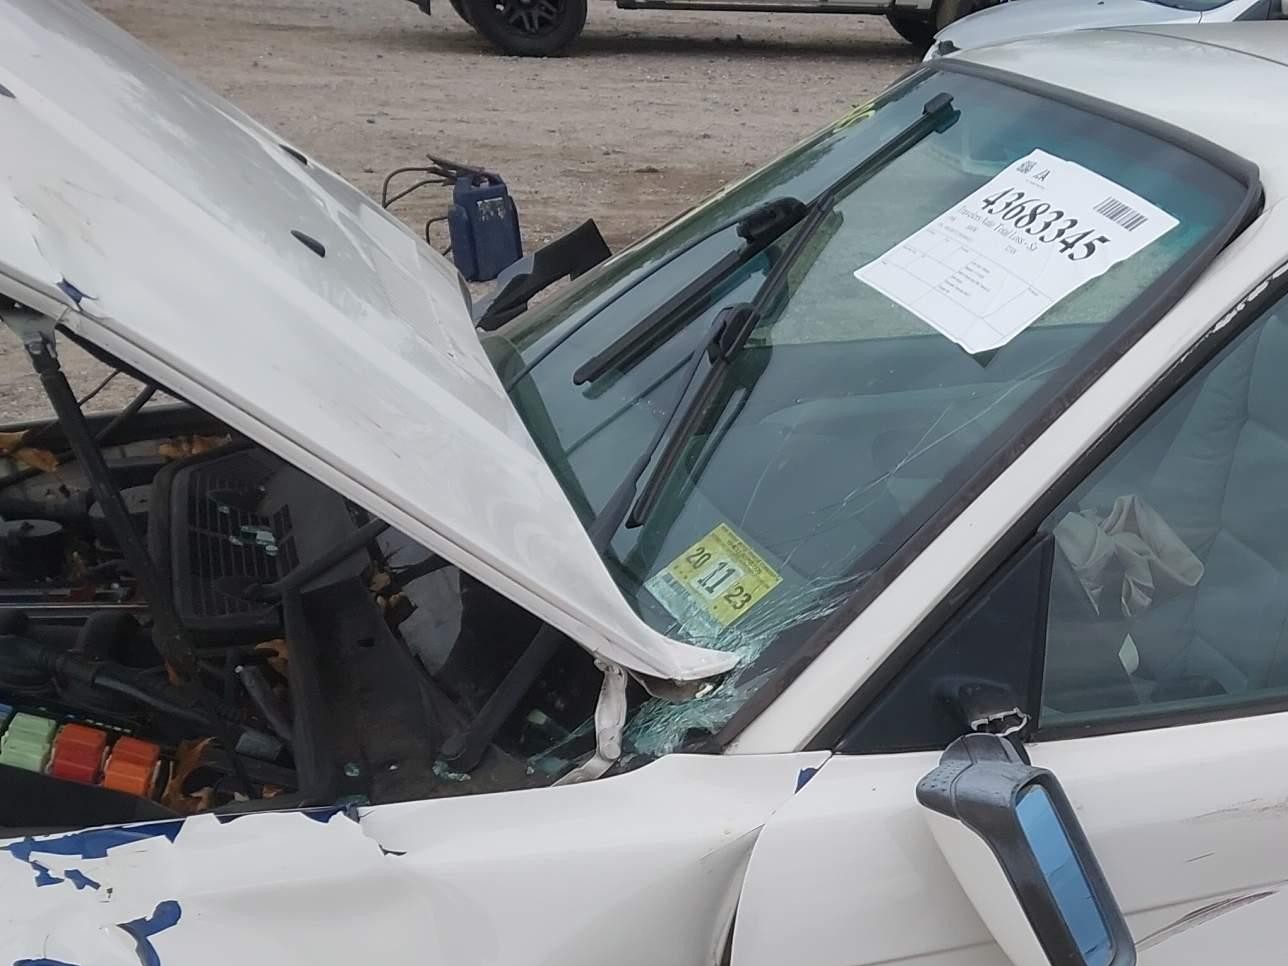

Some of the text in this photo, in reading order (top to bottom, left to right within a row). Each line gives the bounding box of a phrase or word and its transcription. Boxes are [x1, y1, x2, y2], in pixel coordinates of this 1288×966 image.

[982, 187, 1110, 262] 43683345
[686, 547, 712, 570] 20
[697, 561, 736, 595] 11
